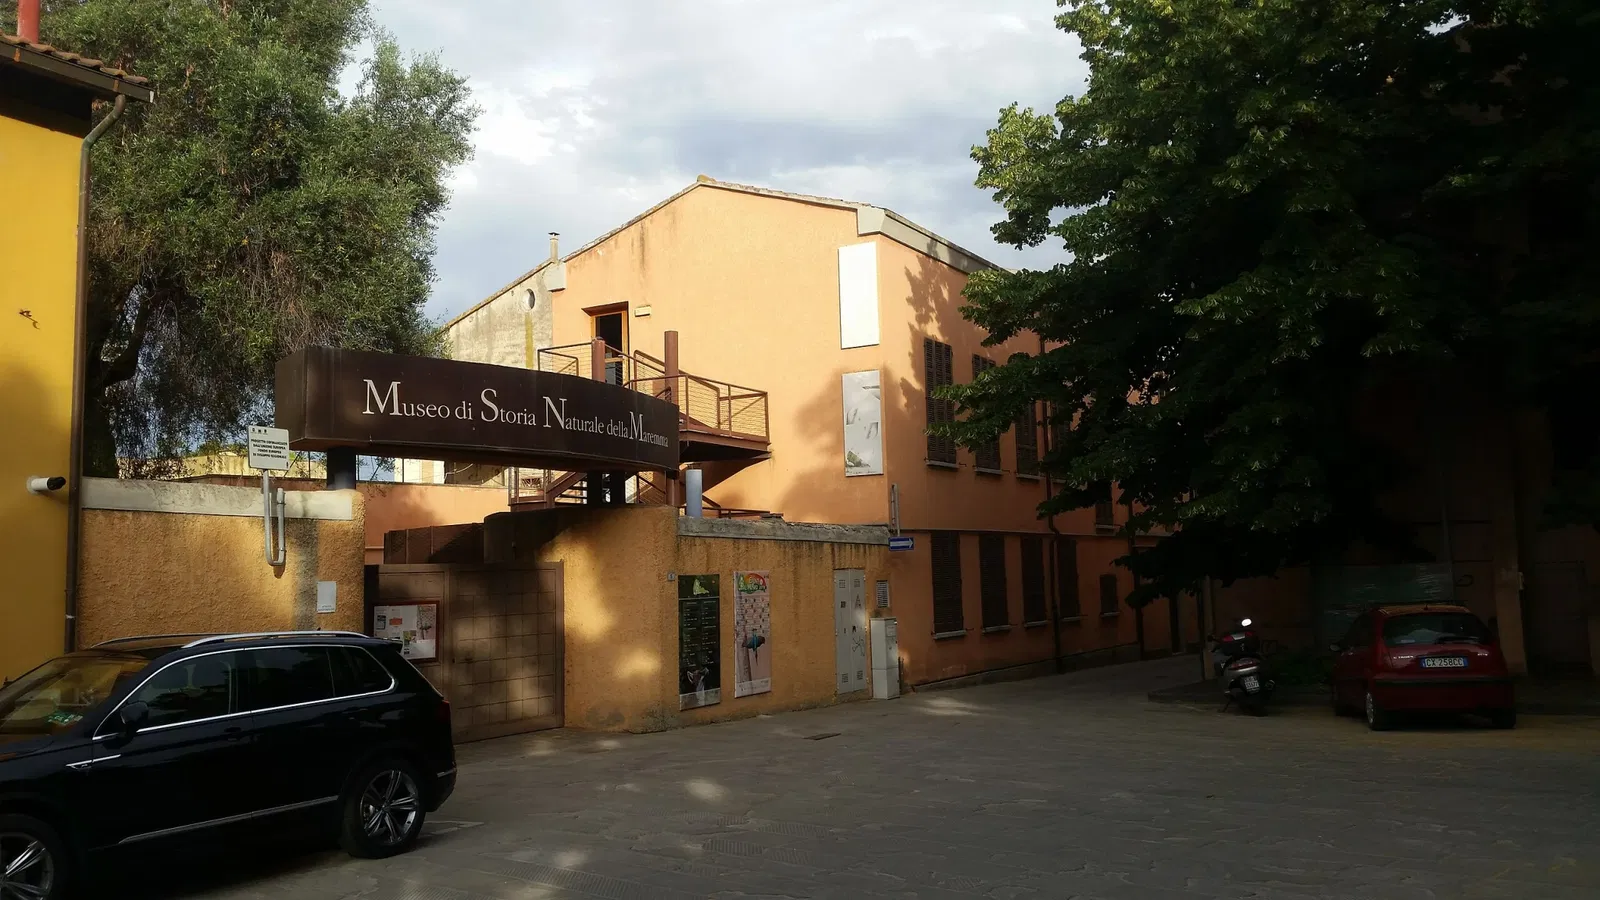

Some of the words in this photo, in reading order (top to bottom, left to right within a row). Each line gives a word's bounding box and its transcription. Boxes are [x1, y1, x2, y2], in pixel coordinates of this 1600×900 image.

[362, 379, 451, 418] Museo
[454, 401, 473, 420] di
[480, 388, 537, 426] Storia
[542, 396, 605, 434] Naturale
[606, 419, 629, 438] della
[629, 411, 669, 447] Maremma
